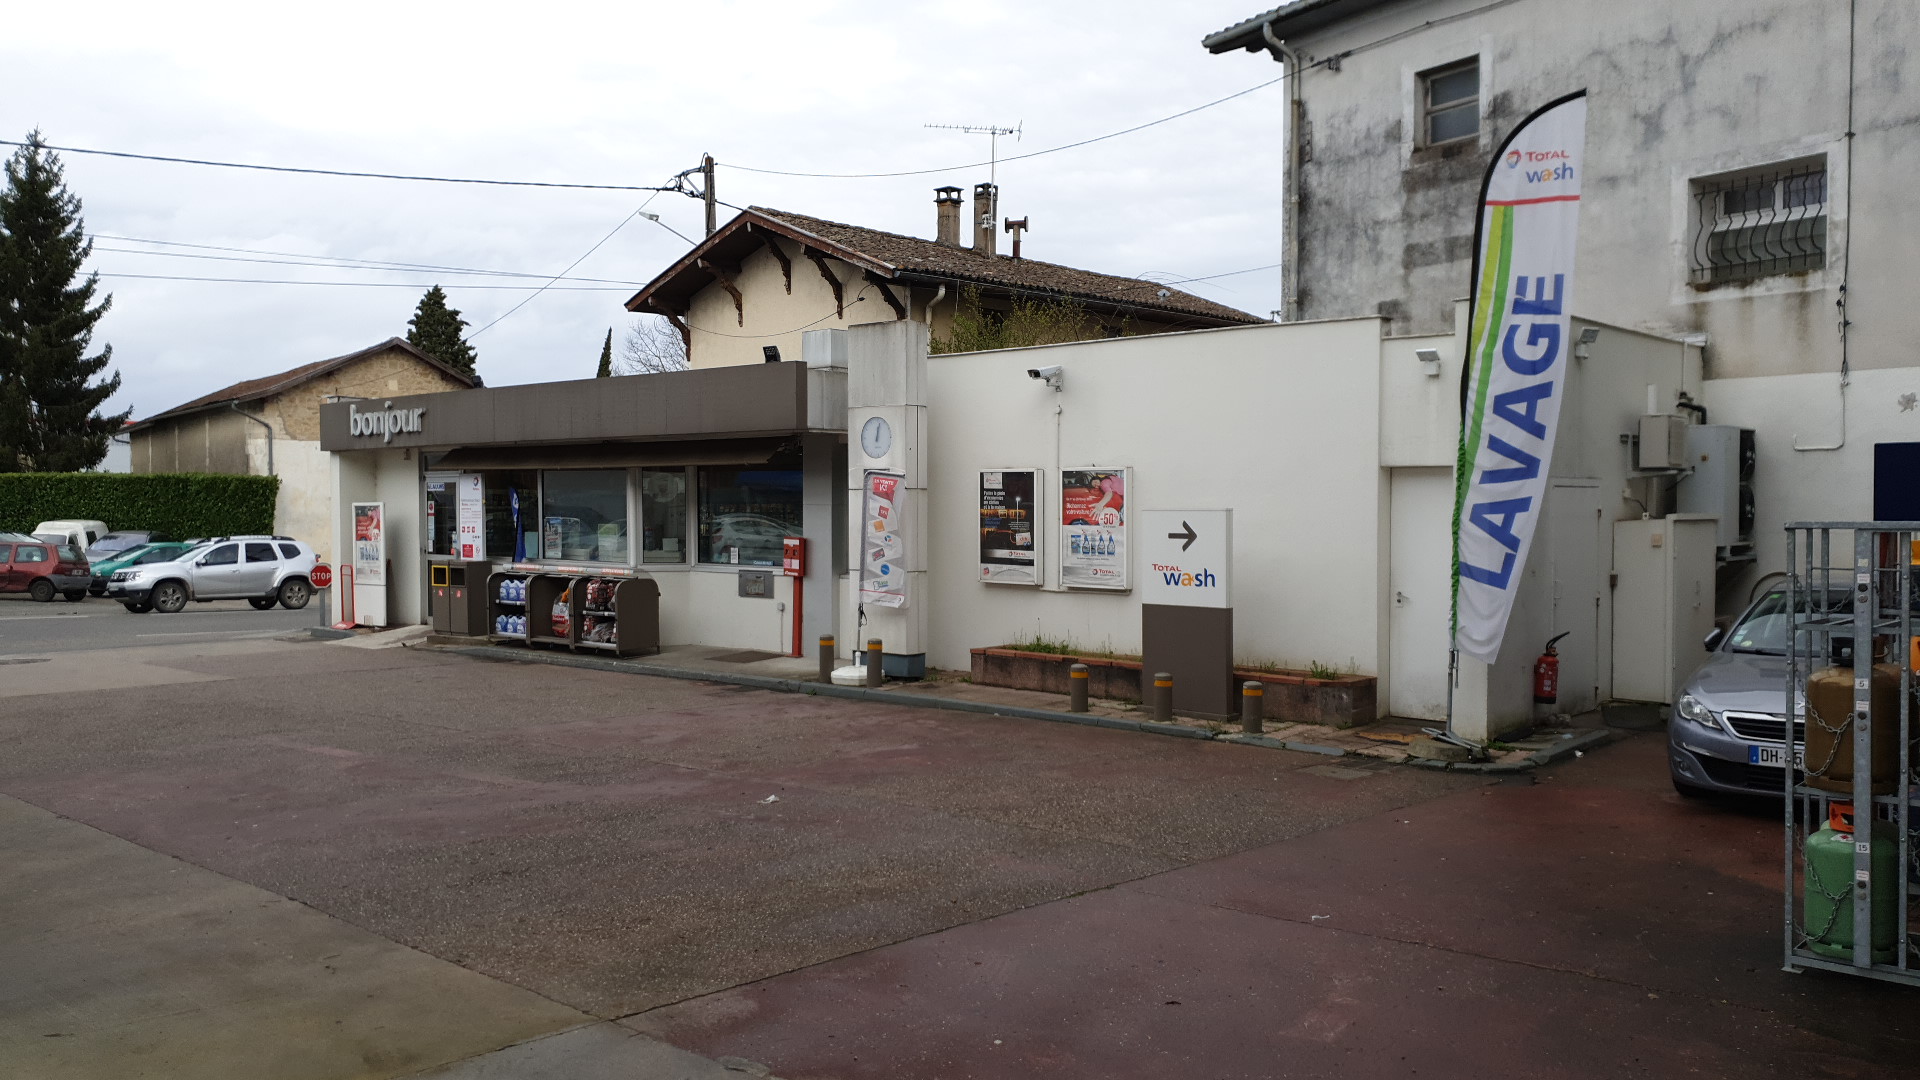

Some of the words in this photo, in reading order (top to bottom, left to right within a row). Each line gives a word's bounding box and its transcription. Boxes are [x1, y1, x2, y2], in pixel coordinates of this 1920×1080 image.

[1525, 150, 1569, 162] TOTAL
[1526, 162, 1573, 183] wash
[350, 400, 426, 443] bonjour
[1459, 273, 1564, 590] LAVAGE
[312, 572, 331, 580] STOP
[1163, 568, 1215, 587] wash
